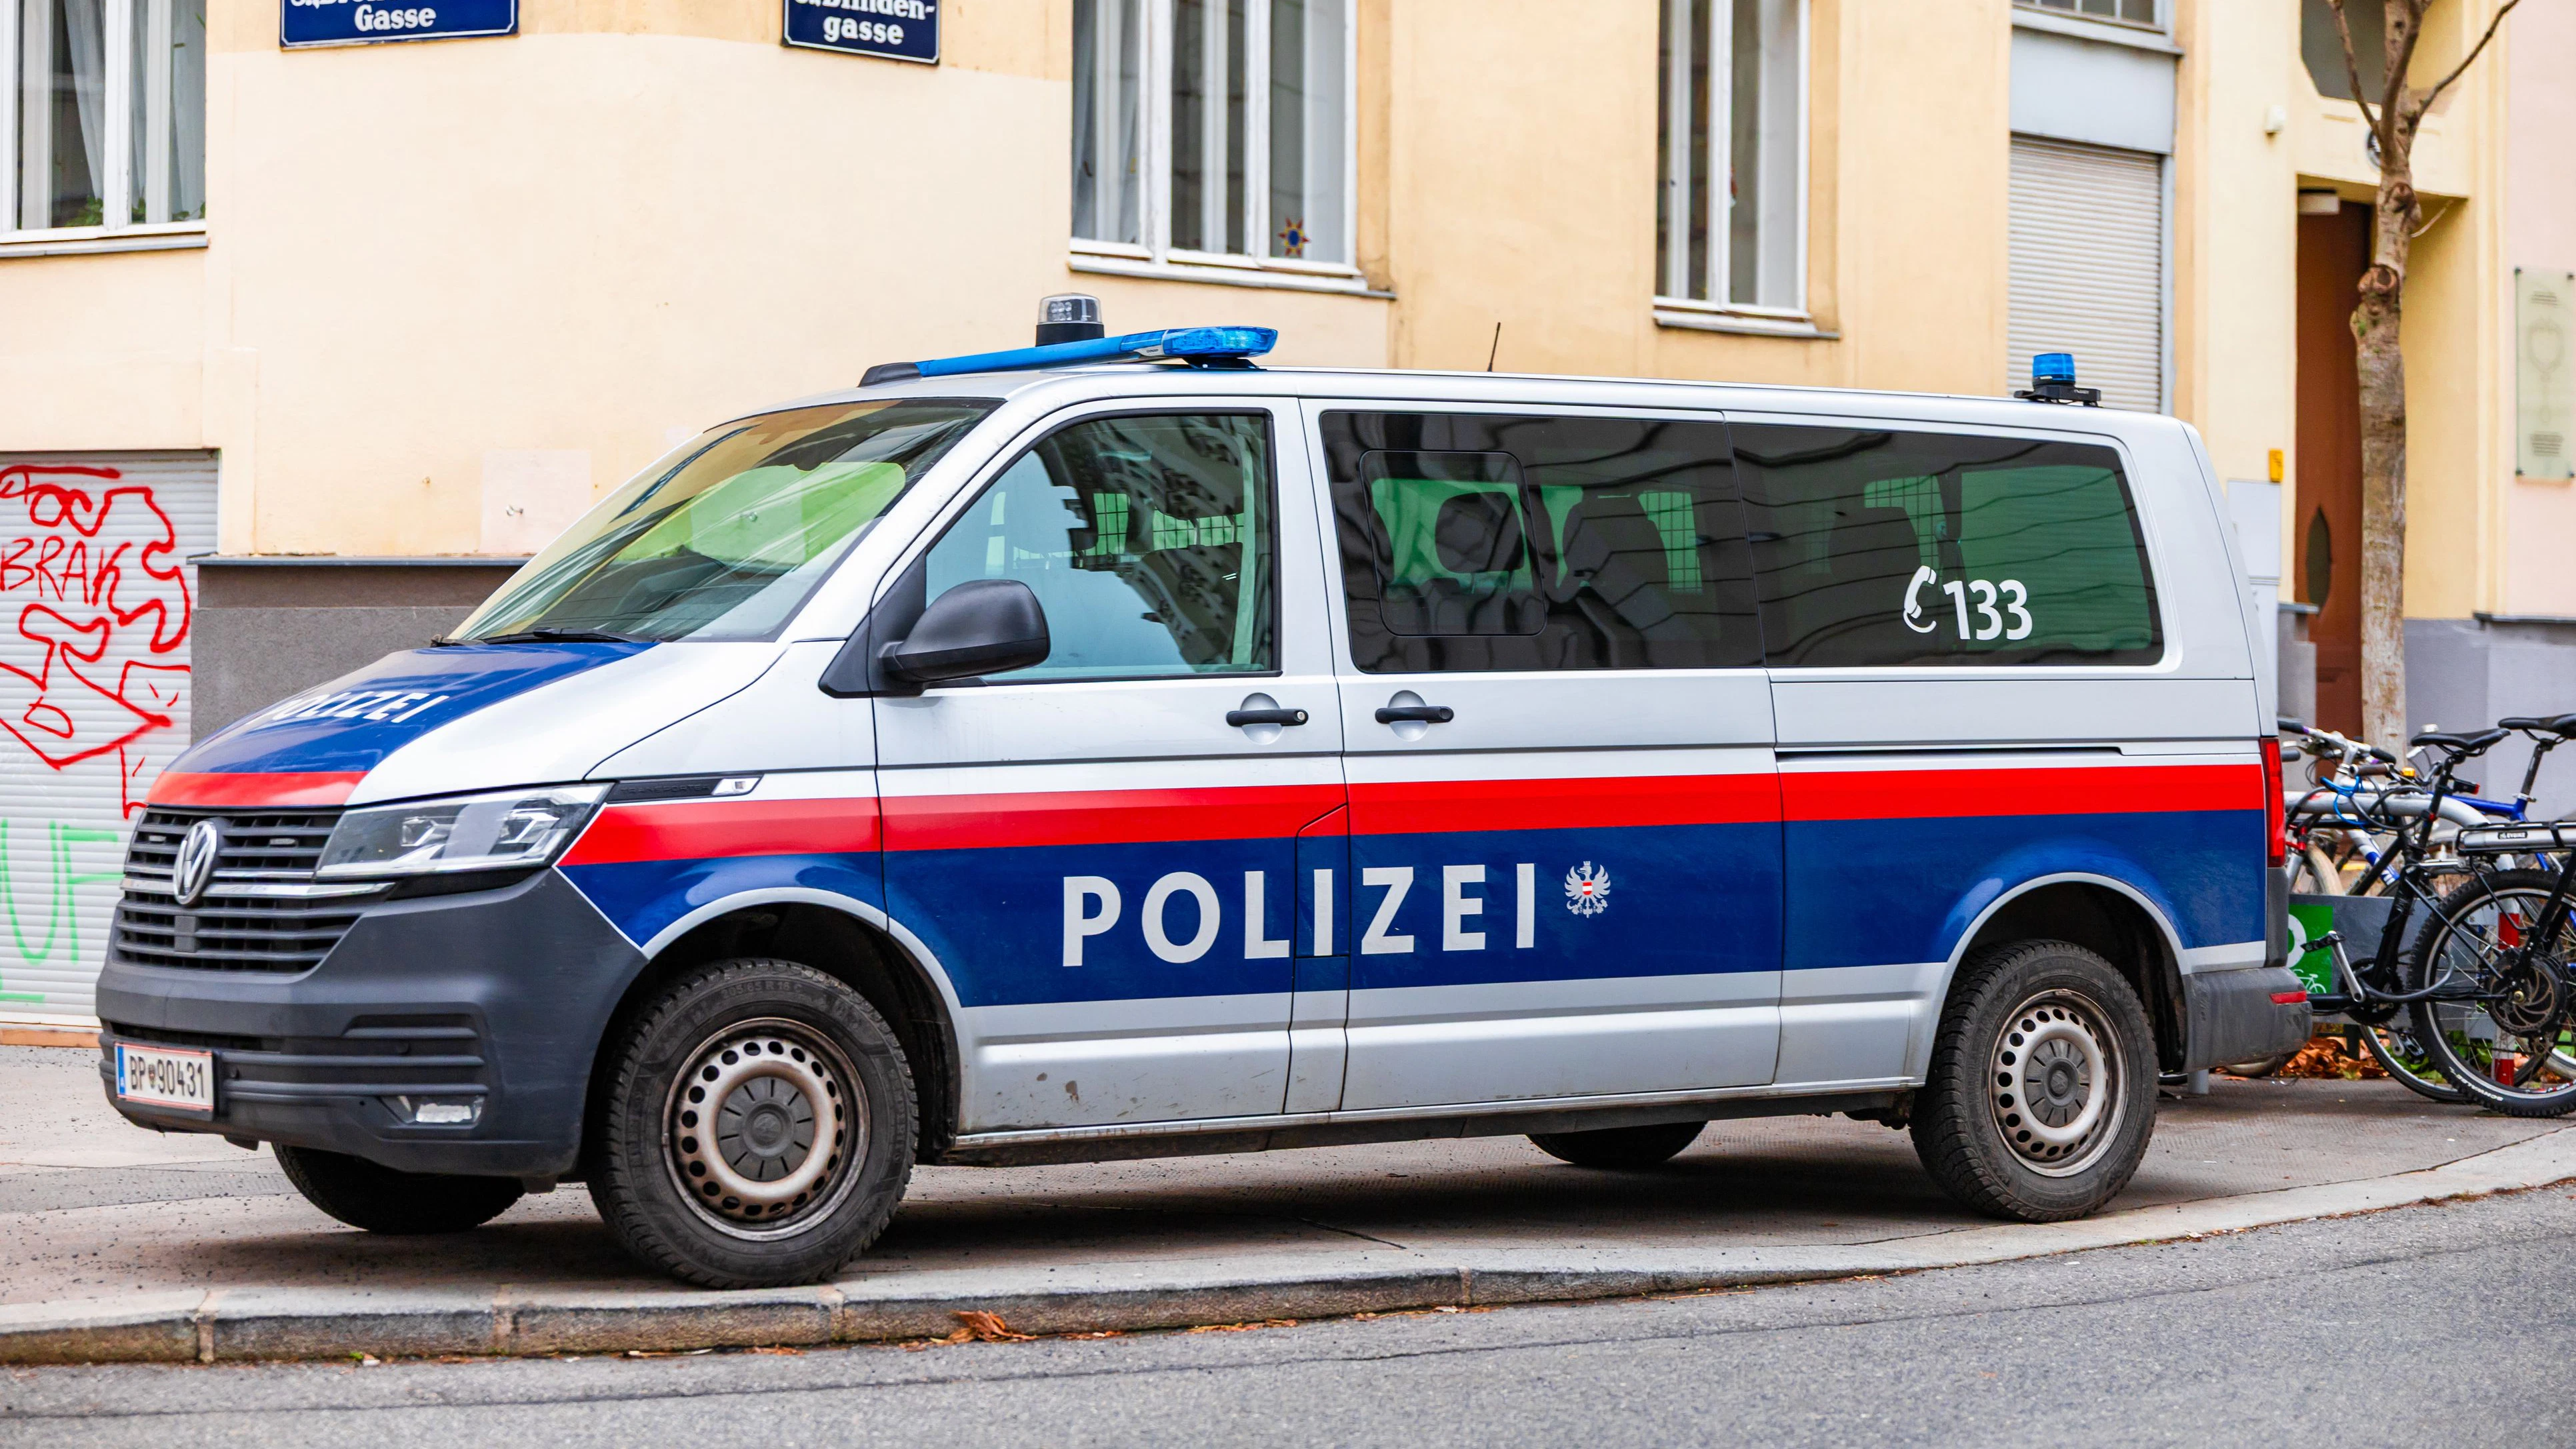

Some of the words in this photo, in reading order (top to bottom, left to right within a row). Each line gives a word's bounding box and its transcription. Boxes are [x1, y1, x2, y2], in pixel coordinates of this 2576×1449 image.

[355, 4, 437, 31] Gasse
[823, 16, 904, 45] gasse
[1943, 579, 2033, 640] 133
[1063, 863, 1535, 967] POLIZEI
[130, 1056, 145, 1090] BP
[157, 1059, 205, 1098] 90431
